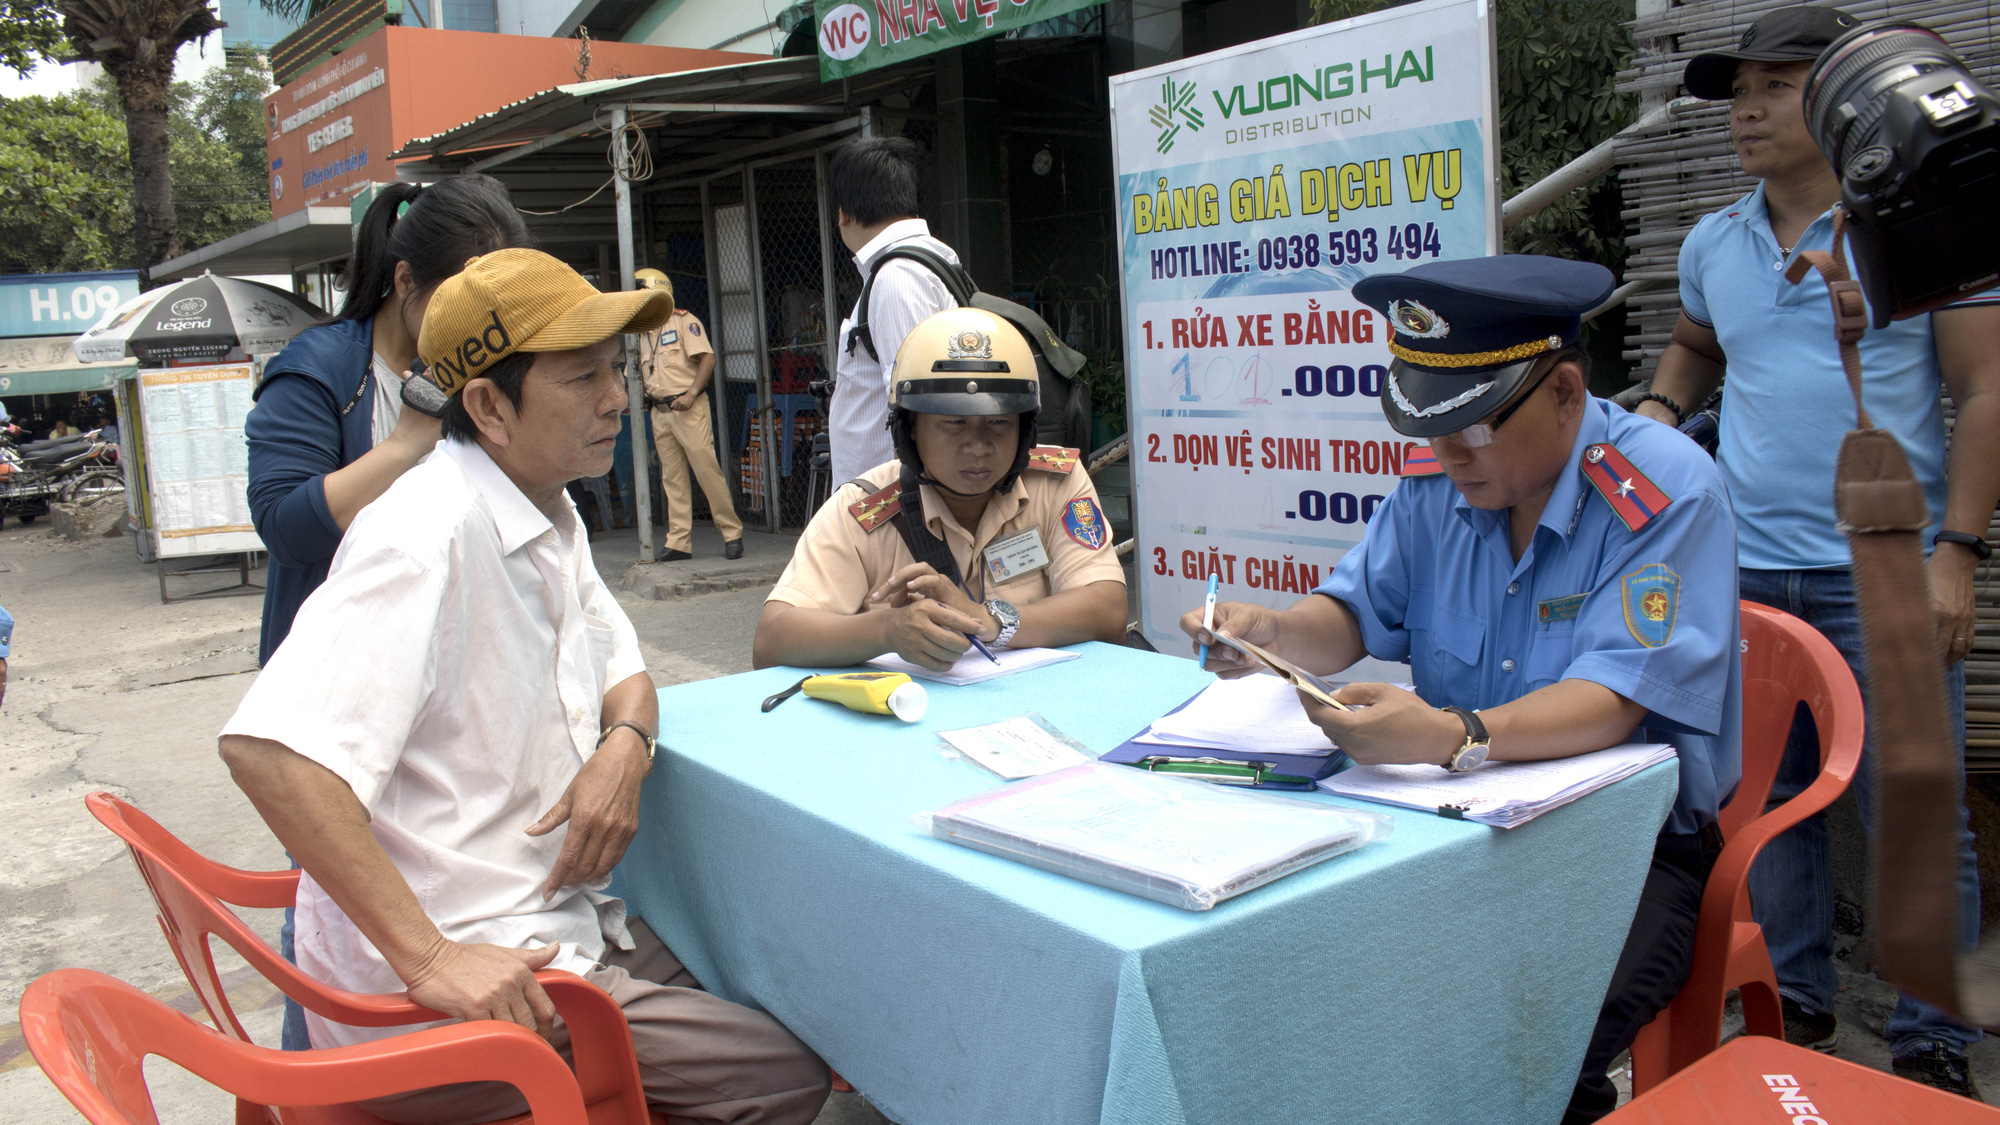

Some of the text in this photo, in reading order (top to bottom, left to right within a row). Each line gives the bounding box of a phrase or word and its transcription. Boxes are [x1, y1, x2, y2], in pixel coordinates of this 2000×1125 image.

[822, 12, 869, 52] WC
[1225, 105, 1371, 144] DISTRIBUTION
[1133, 148, 1461, 235] BẢNG GIÁ DỊCH VỤ
[1150, 222, 1441, 280] HOTLINE: 0938 593 494
[30, 285, 119, 322] H.09
[156, 318, 212, 331] Legend
[1142, 320, 1164, 349] 1.
[1172, 306, 1229, 349] RỬA
[1236, 314, 1274, 347] XE
[1284, 299, 1374, 346] BẰNG
[148, 347, 171, 355] TRUNG
[180, 374, 192, 382] TIN
[1148, 433, 1167, 463] 2.
[1173, 434, 1218, 472] DỌN
[1225, 429, 1254, 474] VỆ
[1261, 436, 1321, 472] SINH
[1153, 546, 1174, 577] 3.
[1245, 554, 1319, 595] CHĂN
